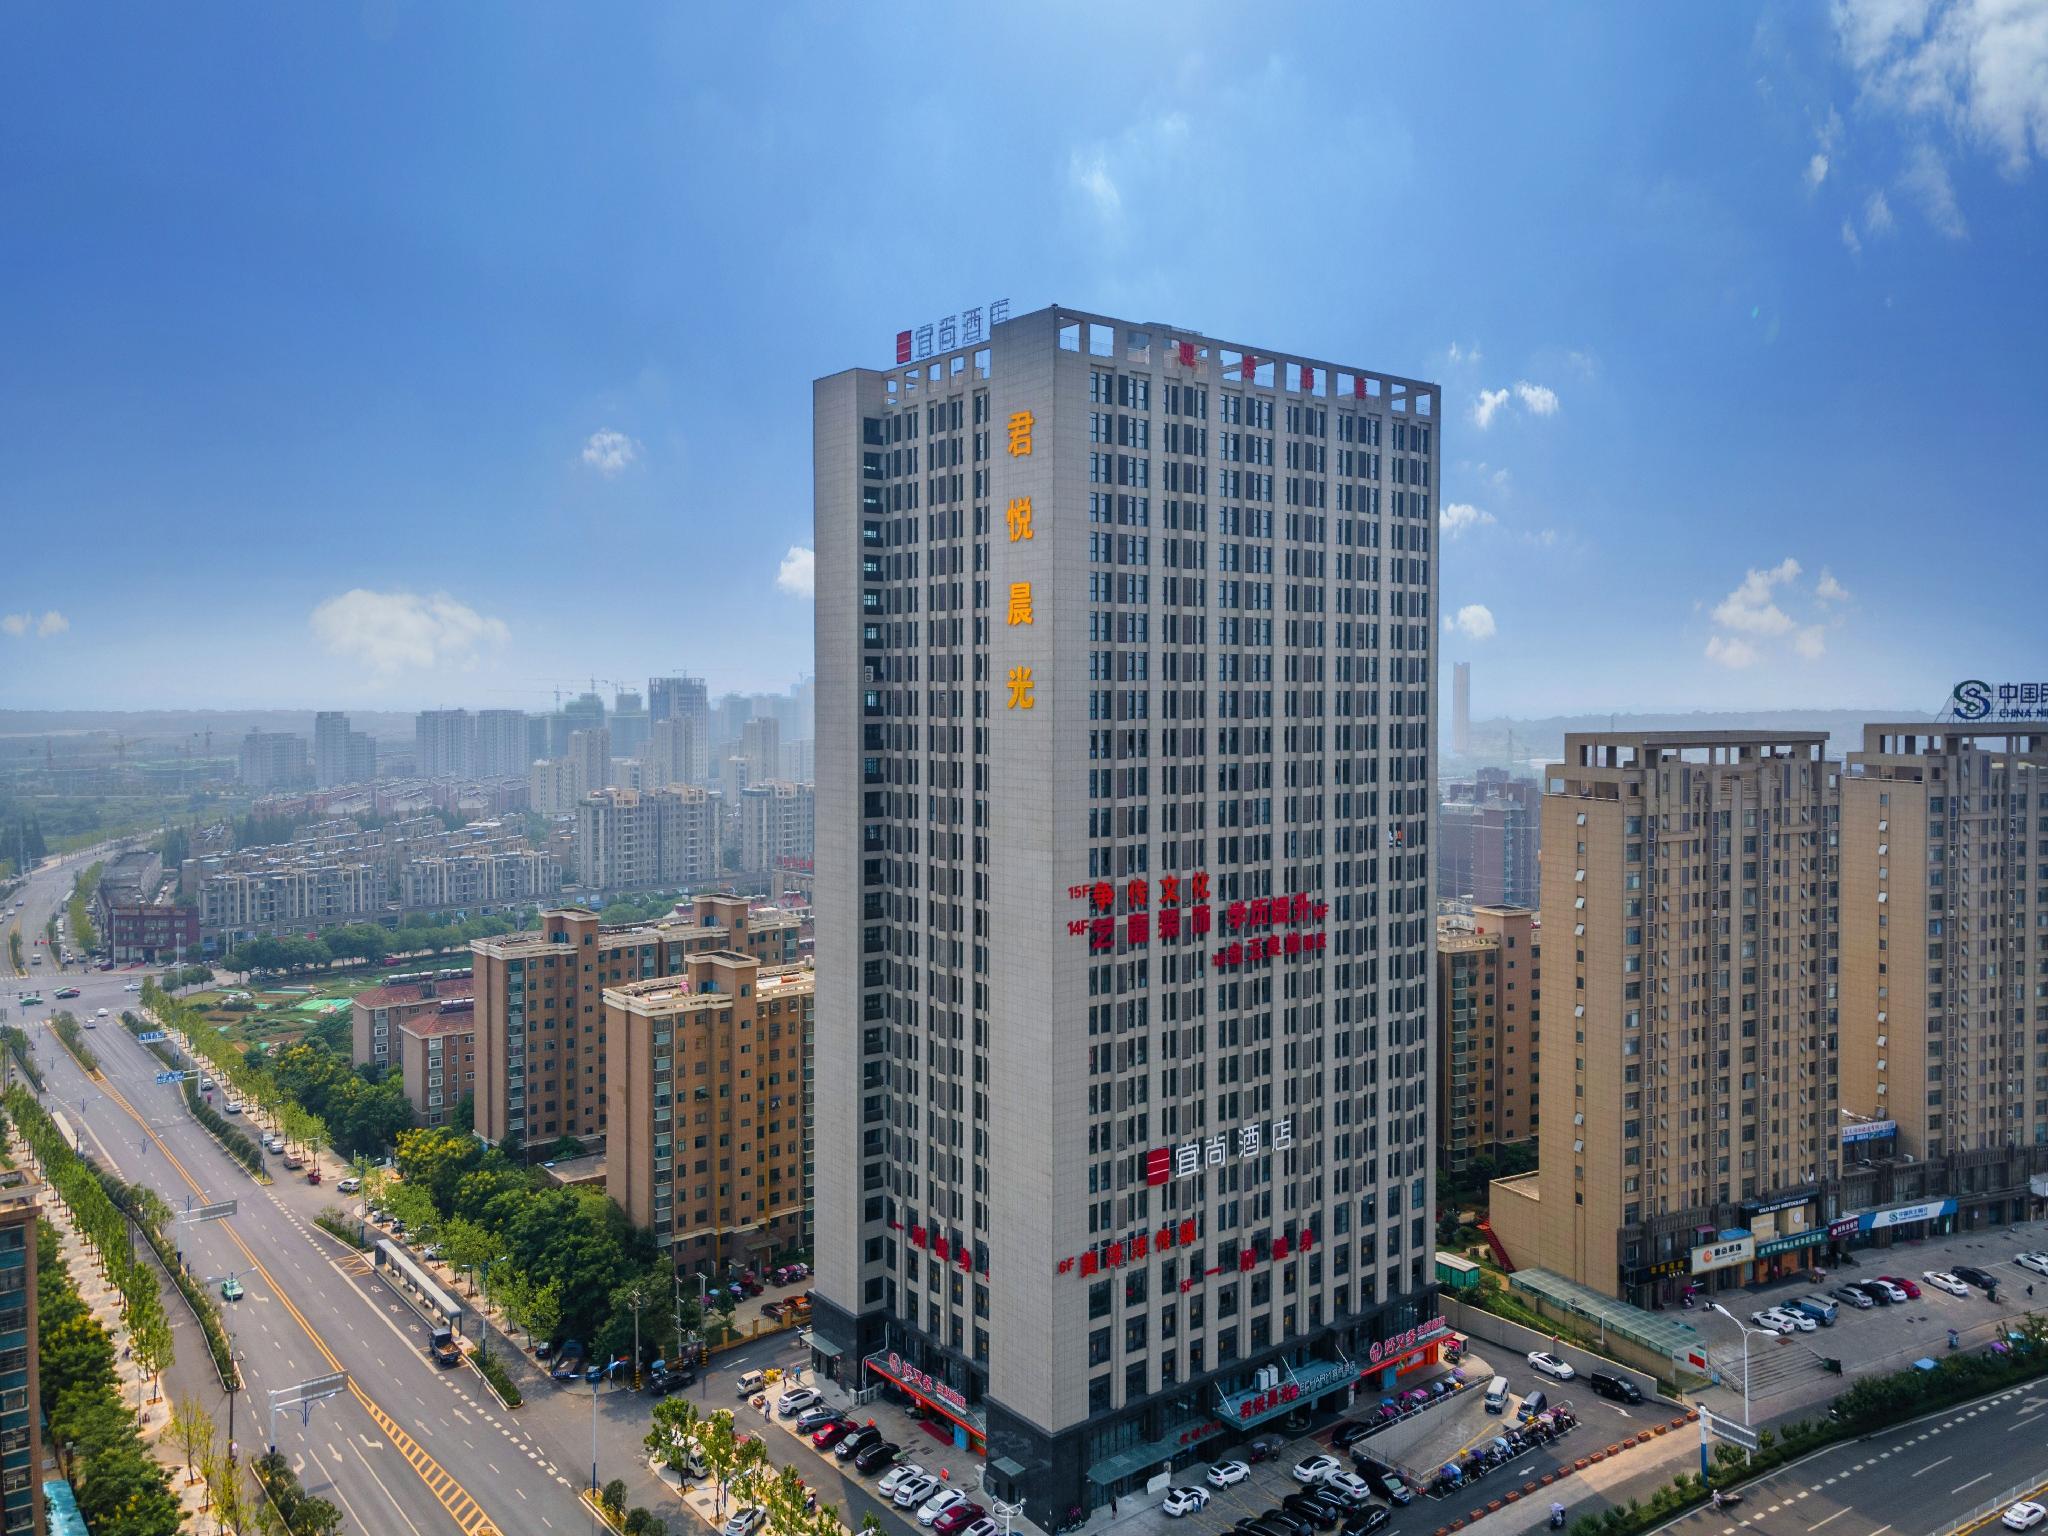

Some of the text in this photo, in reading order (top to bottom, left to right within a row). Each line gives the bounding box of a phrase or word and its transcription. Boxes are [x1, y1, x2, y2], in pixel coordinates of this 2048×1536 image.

[915, 298, 1010, 358] 宜尚酒店
[1006, 409, 1035, 709] 君悦晨光
[1999, 708, 2031, 718] CHINA
[1067, 884, 1090, 899] 15F
[1067, 919, 1089, 936] 14F
[1175, 1119, 1292, 1178] 宜尚酒店
[1384, 1328, 1416, 1356] 好又多
